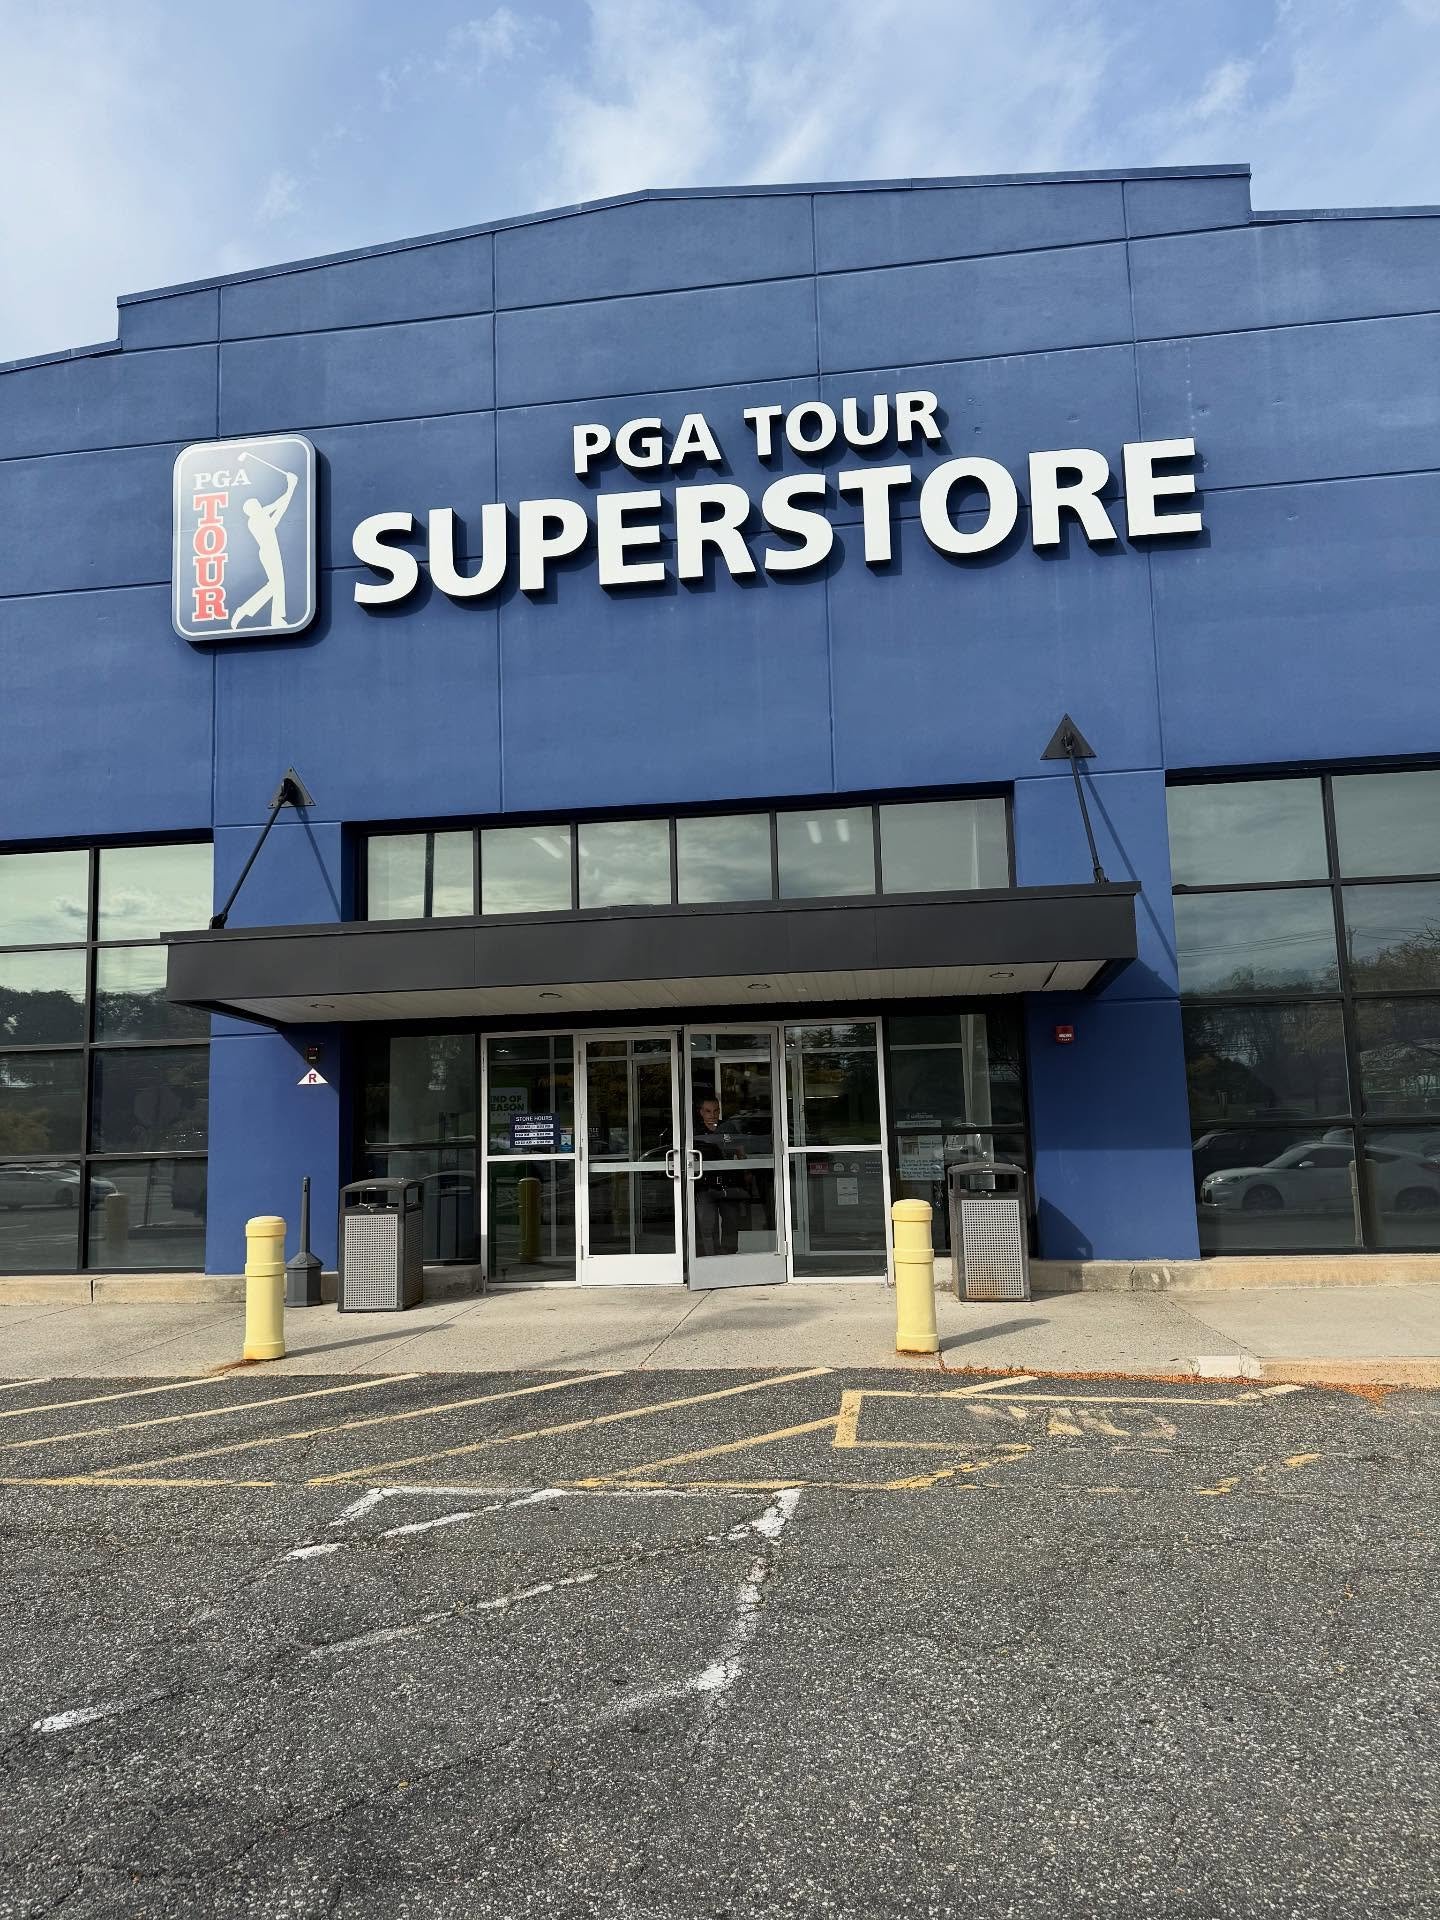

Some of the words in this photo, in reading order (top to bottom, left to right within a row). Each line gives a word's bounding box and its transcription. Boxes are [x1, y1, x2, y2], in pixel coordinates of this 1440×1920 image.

[572, 412, 723, 477] PGA
[743, 390, 943, 458] TOUR
[193, 469, 252, 491] PGA
[351, 437, 1204, 606] SUPERSTORE
[192, 492, 229, 622] TOUR
[308, 1073, 317, 1084] R
[490, 1103, 525, 1112] EASON
